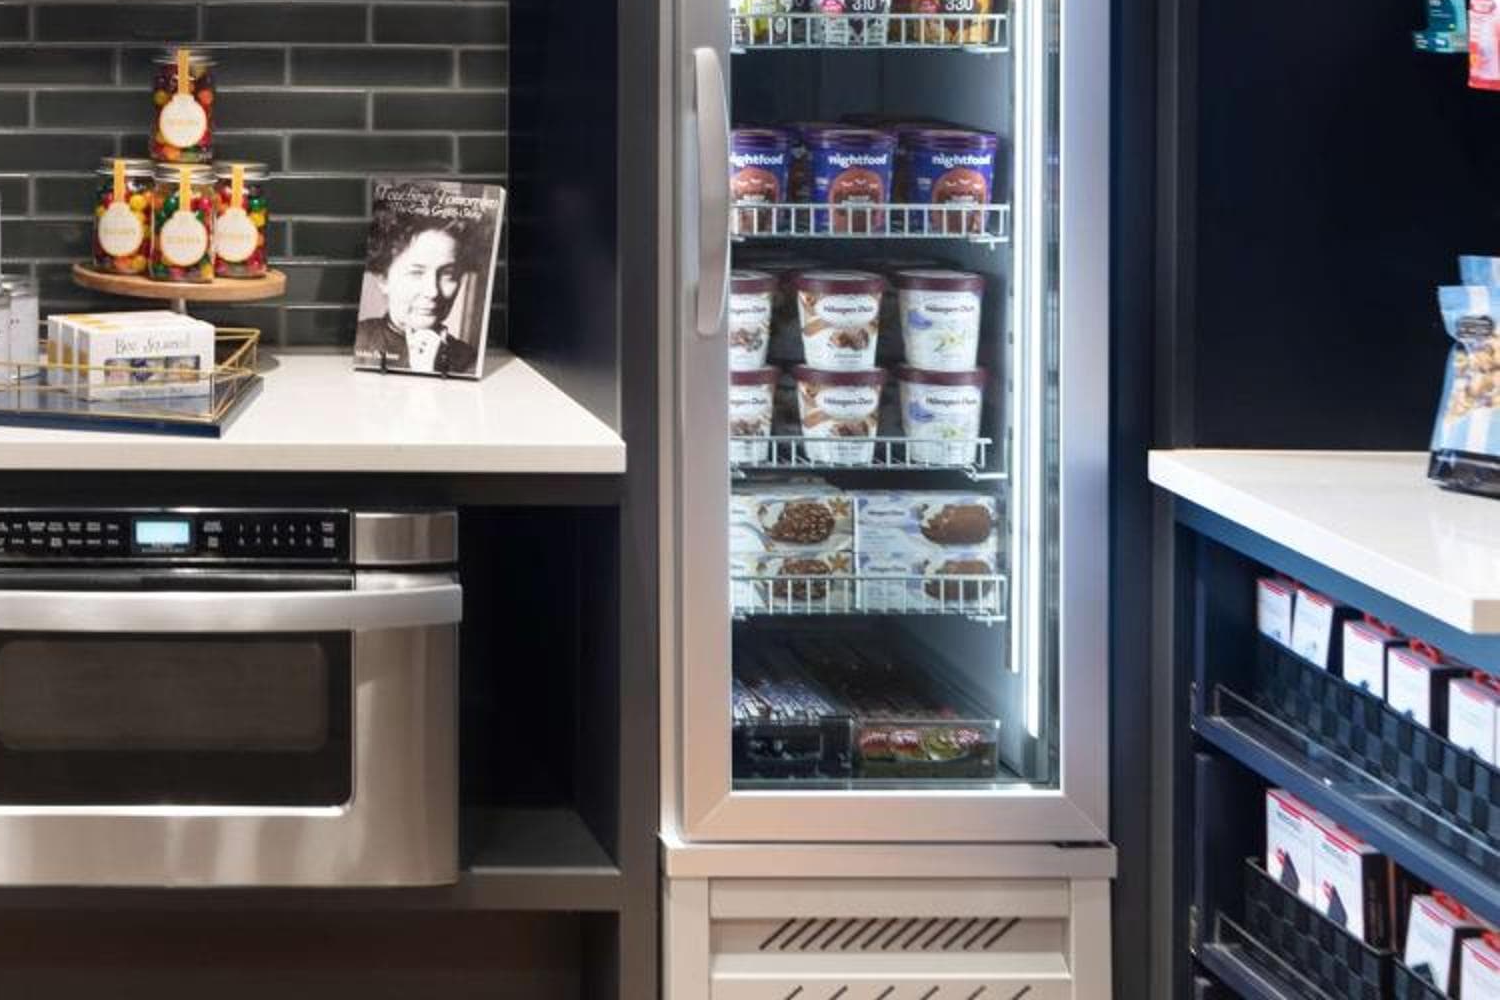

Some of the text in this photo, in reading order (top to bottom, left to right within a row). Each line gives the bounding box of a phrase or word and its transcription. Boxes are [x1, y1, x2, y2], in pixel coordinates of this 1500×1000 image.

[730, 153, 784, 168] ightfood
[828, 152, 888, 169] nightfood
[931, 152, 992, 169] nightfood
